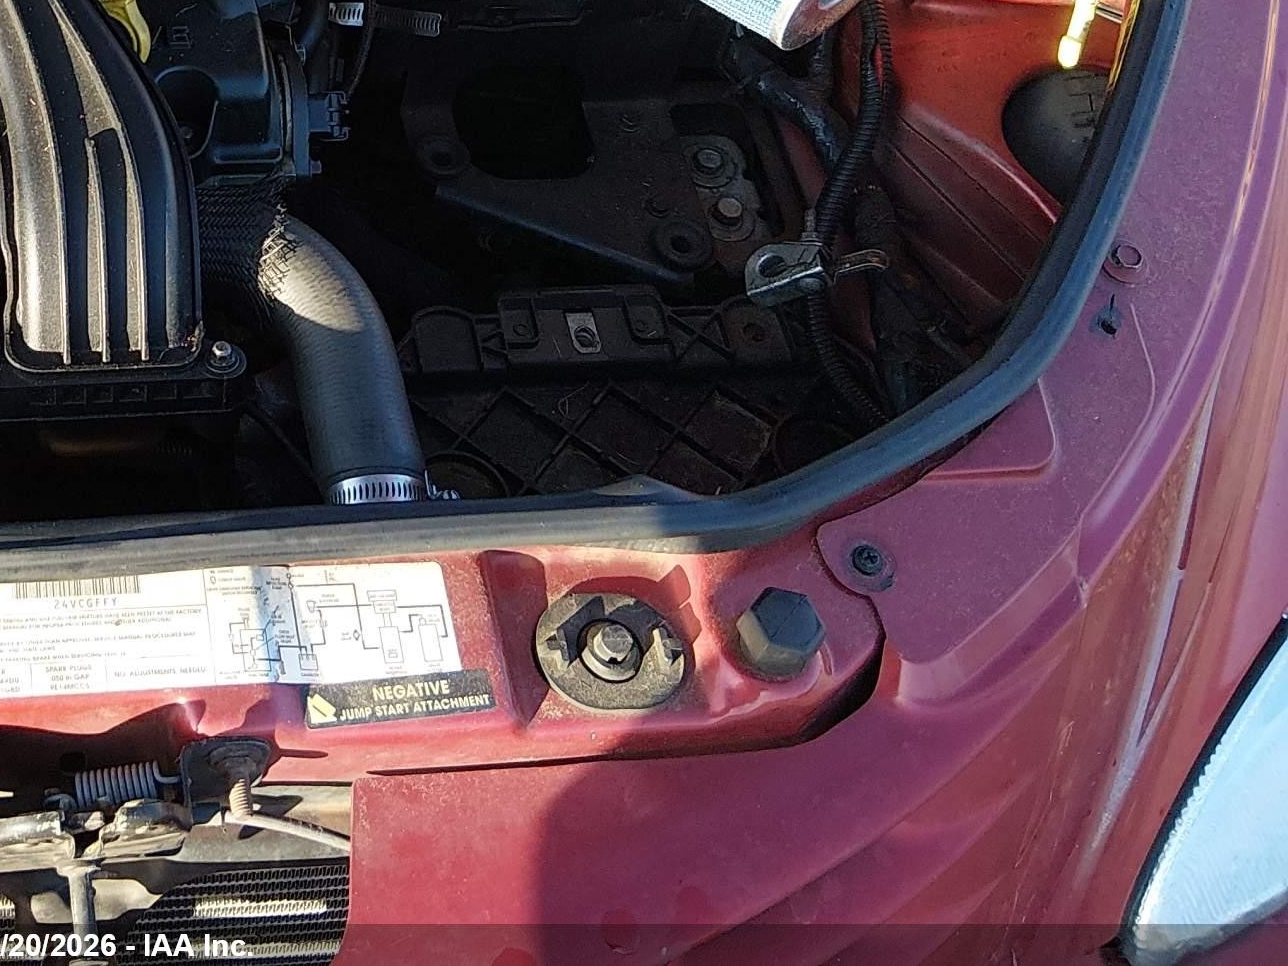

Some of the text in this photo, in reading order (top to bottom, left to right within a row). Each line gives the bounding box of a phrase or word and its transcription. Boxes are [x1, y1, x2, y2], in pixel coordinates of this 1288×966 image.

[372, 680, 450, 701] NEGATIVE
[339, 693, 491, 721] JUMP START ATTACHMENT
